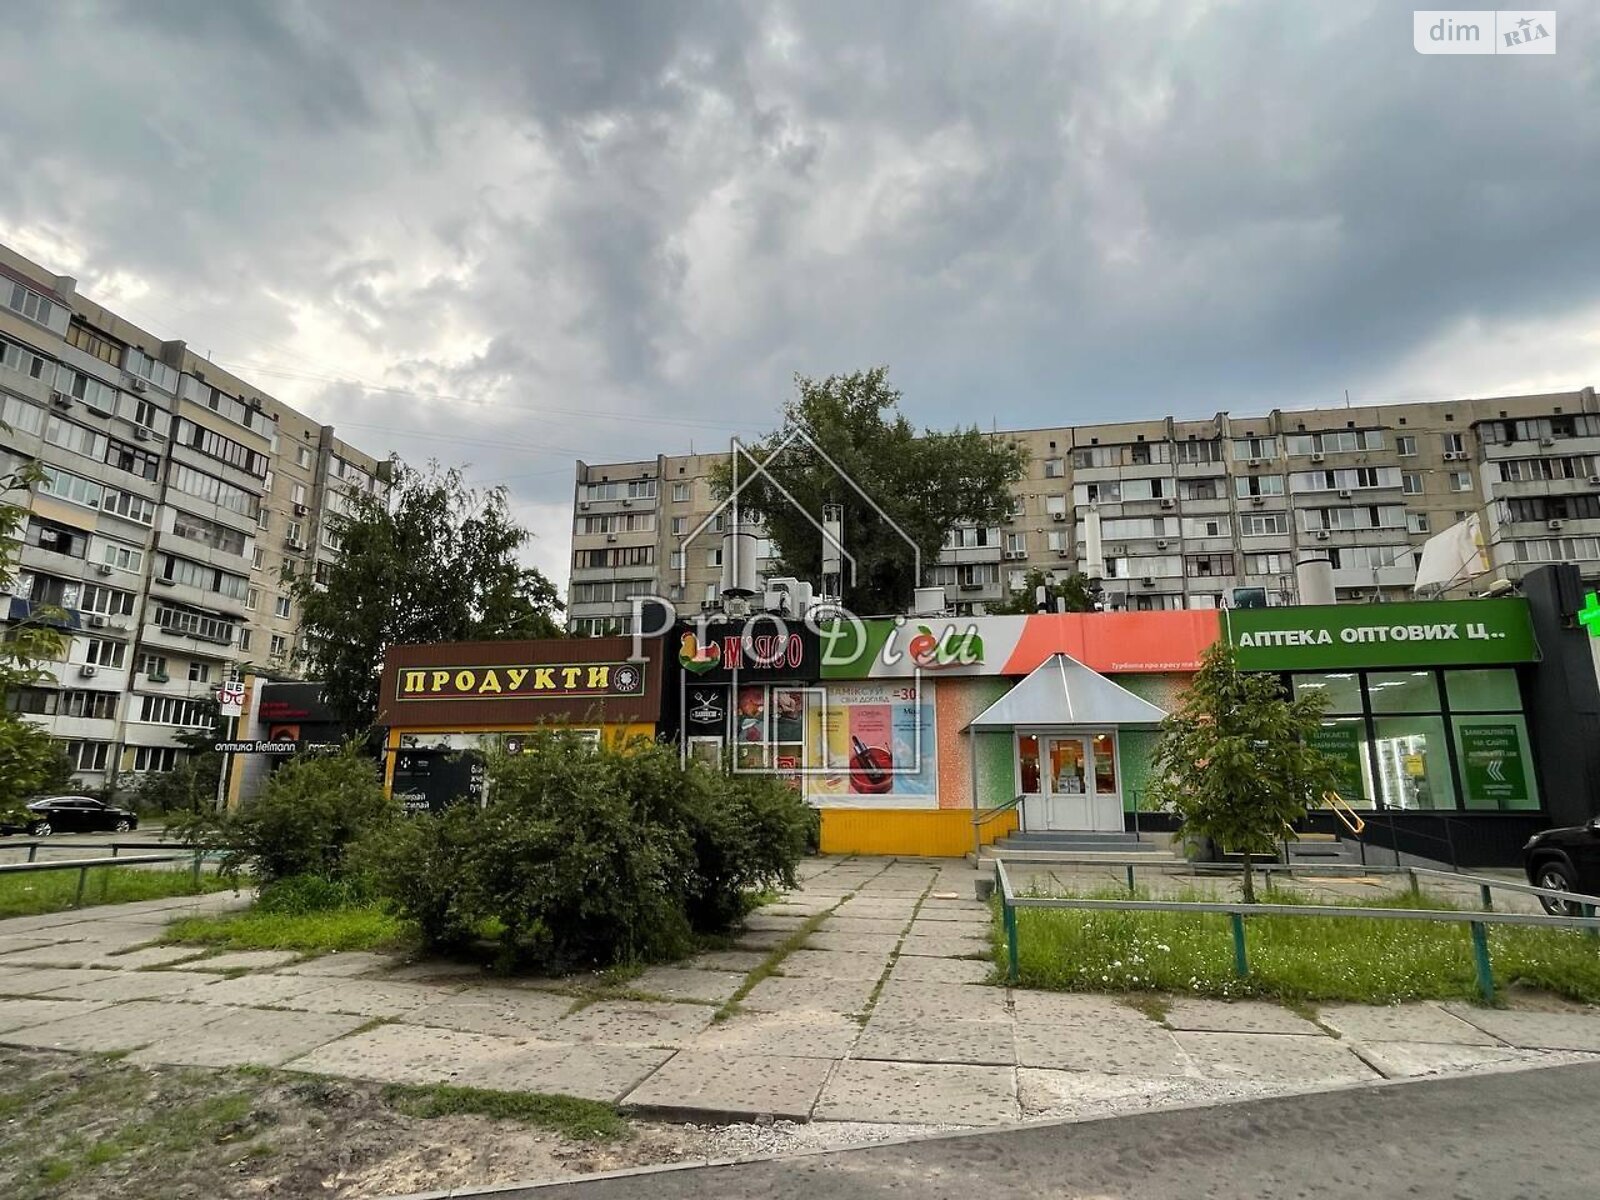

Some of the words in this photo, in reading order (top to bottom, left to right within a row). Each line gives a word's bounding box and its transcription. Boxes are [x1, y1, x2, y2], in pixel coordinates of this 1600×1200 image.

[1239, 629, 1333, 648] АПТЕКА
[1340, 624, 1459, 644] ОПТОВИХ
[404, 666, 610, 693] ПРОДУКТИ
